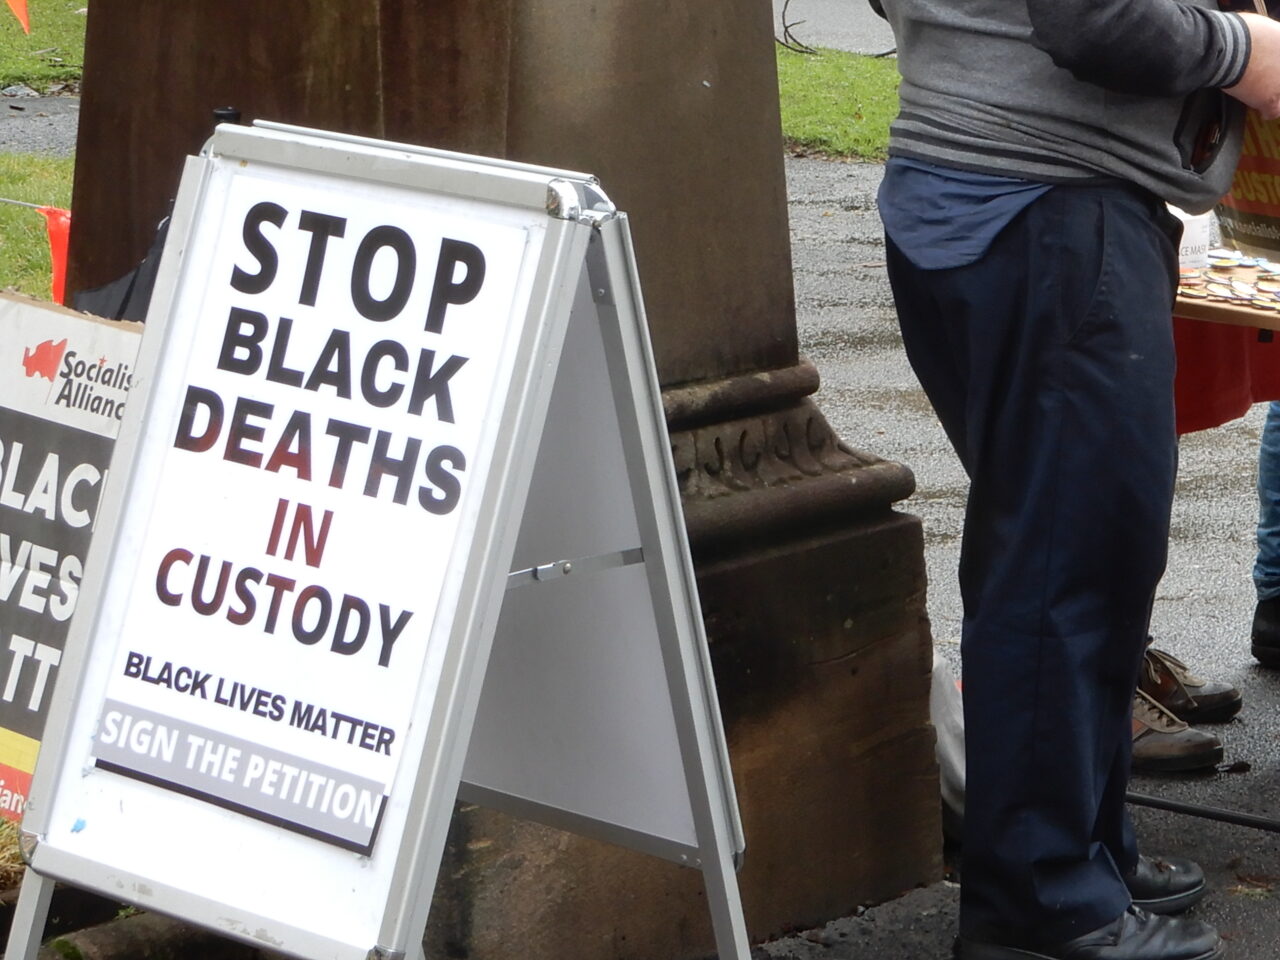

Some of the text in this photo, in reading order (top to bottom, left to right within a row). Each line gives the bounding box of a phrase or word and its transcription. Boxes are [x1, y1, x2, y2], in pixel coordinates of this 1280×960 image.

[230, 201, 487, 335] STOP
[217, 306, 470, 424] BLACK
[173, 385, 467, 516] DEATHS
[266, 498, 334, 569] IN
[156, 548, 415, 668] CUSTODY
[124, 651, 396, 757] BLACK LIVES MATTER
[101, 710, 382, 830] SIGN THE PETITION
